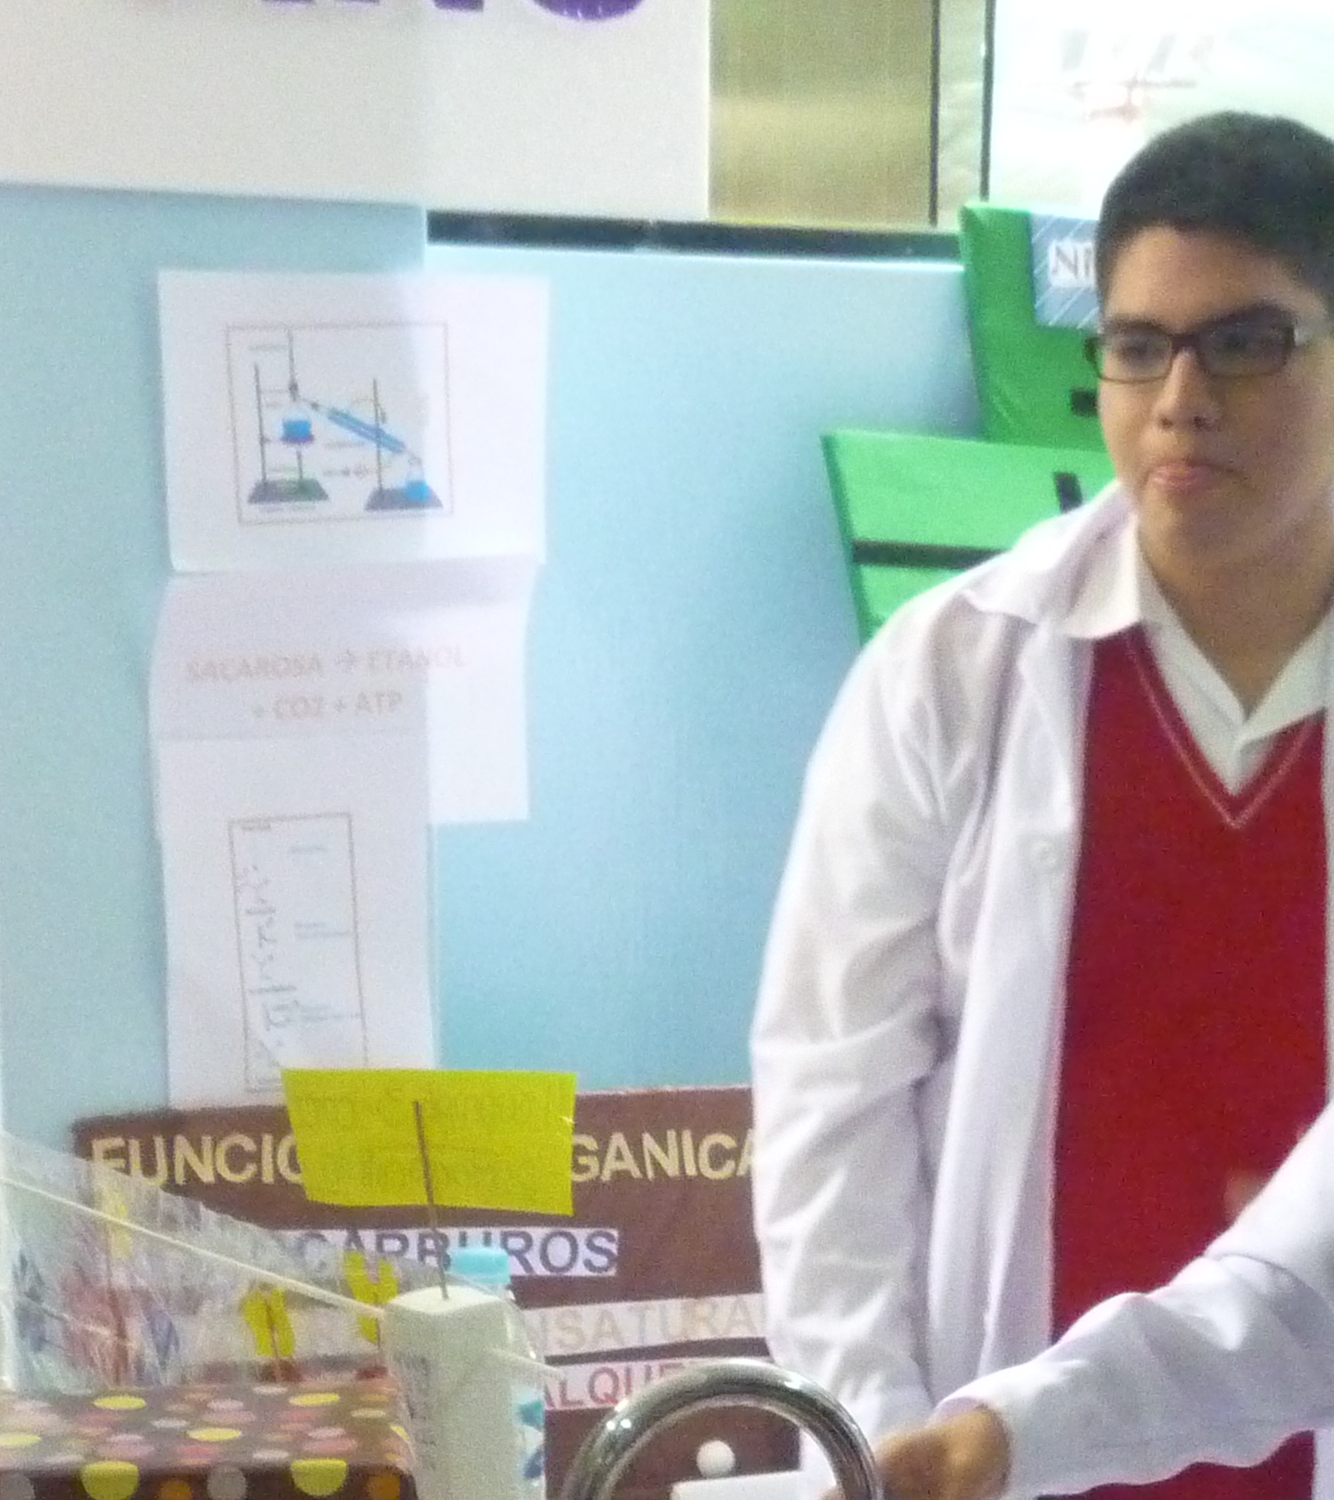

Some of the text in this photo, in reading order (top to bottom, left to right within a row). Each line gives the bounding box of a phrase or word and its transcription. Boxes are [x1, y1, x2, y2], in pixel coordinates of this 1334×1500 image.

[186, 646, 468, 683] SACAROSA ETANOL
[91, 1133, 307, 1186] FUNCIO
